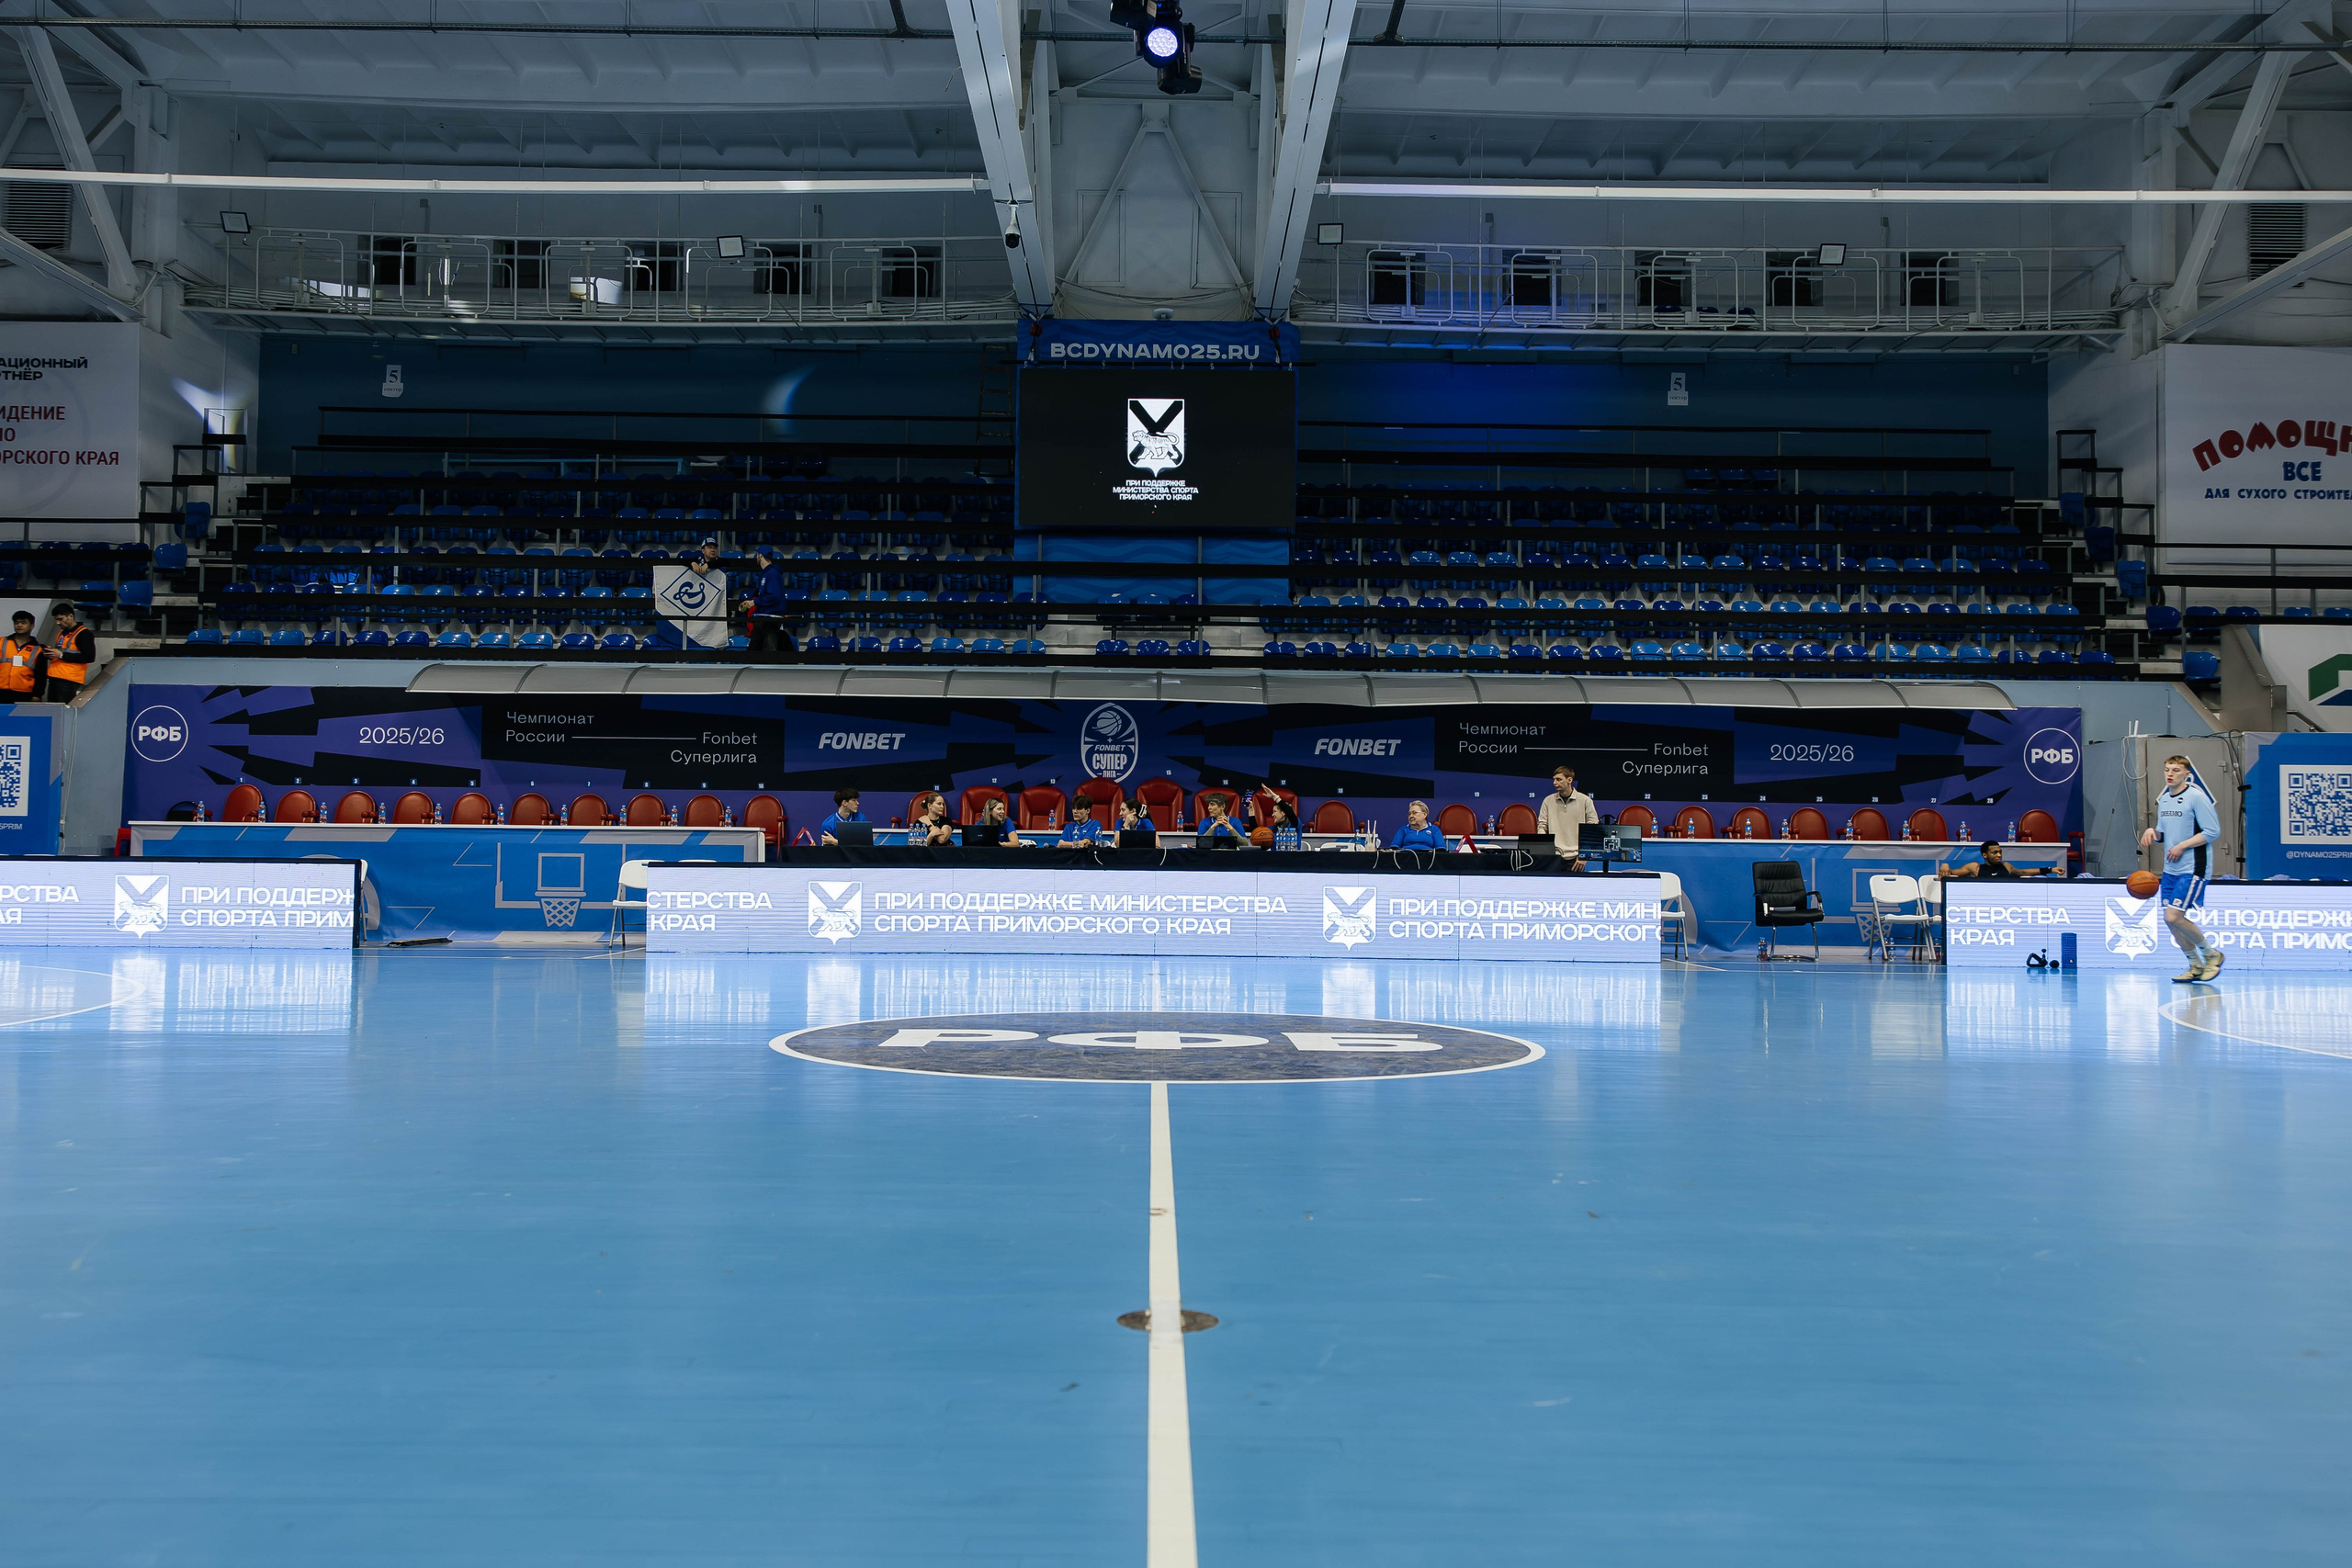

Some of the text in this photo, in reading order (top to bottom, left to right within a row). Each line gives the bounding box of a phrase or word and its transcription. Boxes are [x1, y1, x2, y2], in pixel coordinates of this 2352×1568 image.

[1050, 343, 1260, 360] BCDYNAMO25.RU
[389, 369, 398, 383] 5
[1673, 378, 1682, 391] 5
[75, 450, 119, 466] КРАЯ
[2282, 461, 2323, 481] ВСЕ
[1142, 479, 1186, 488] ПОДДЕРЖКЕ
[2204, 488, 2230, 499] ДЛЯ
[2237, 488, 2287, 500] СУХОГО
[506, 711, 594, 725] Чемпионат
[138, 726, 182, 742] РФБ
[359, 727, 445, 745] 2025/26
[506, 729, 757, 745] России Fonbet
[1459, 722, 1546, 736] Чемпионат
[819, 732, 906, 750] FONBET
[1315, 739, 1401, 756] FONBET
[1459, 740, 1709, 756] России Fonbet
[671, 750, 757, 765] Суперлига
[1091, 753, 1127, 770] СУПЕР
[1770, 744, 1855, 762] 2025/26
[2030, 749, 2074, 764] РФБ
[1102, 770, 1116, 778] ЛИГА
[1622, 761, 1709, 776] Суперлига
[181, 886, 355, 908] ПРИ ПОДДЕРЖ
[647, 891, 773, 909] СТЕРСТВА
[875, 893, 1289, 913] ПРИ ПОДДЕРЖКЕ МИНИСТЕРСТВА
[1388, 898, 1438, 916] ПРИ
[1443, 899, 1596, 919] ПОДДЕРЖКЕ
[1946, 906, 2071, 924] СТЕРСТВА
[181, 909, 354, 928] СПОРТА ПРИМ
[650, 914, 716, 931] КРАЯ
[874, 915, 1231, 935] СПОРТА ПРИМОРСКОГО КРАЯ
[1388, 921, 1486, 939] СПОРТА
[1951, 928, 2015, 946] КРАЯ
[877, 1028, 1443, 1052] РФБ
